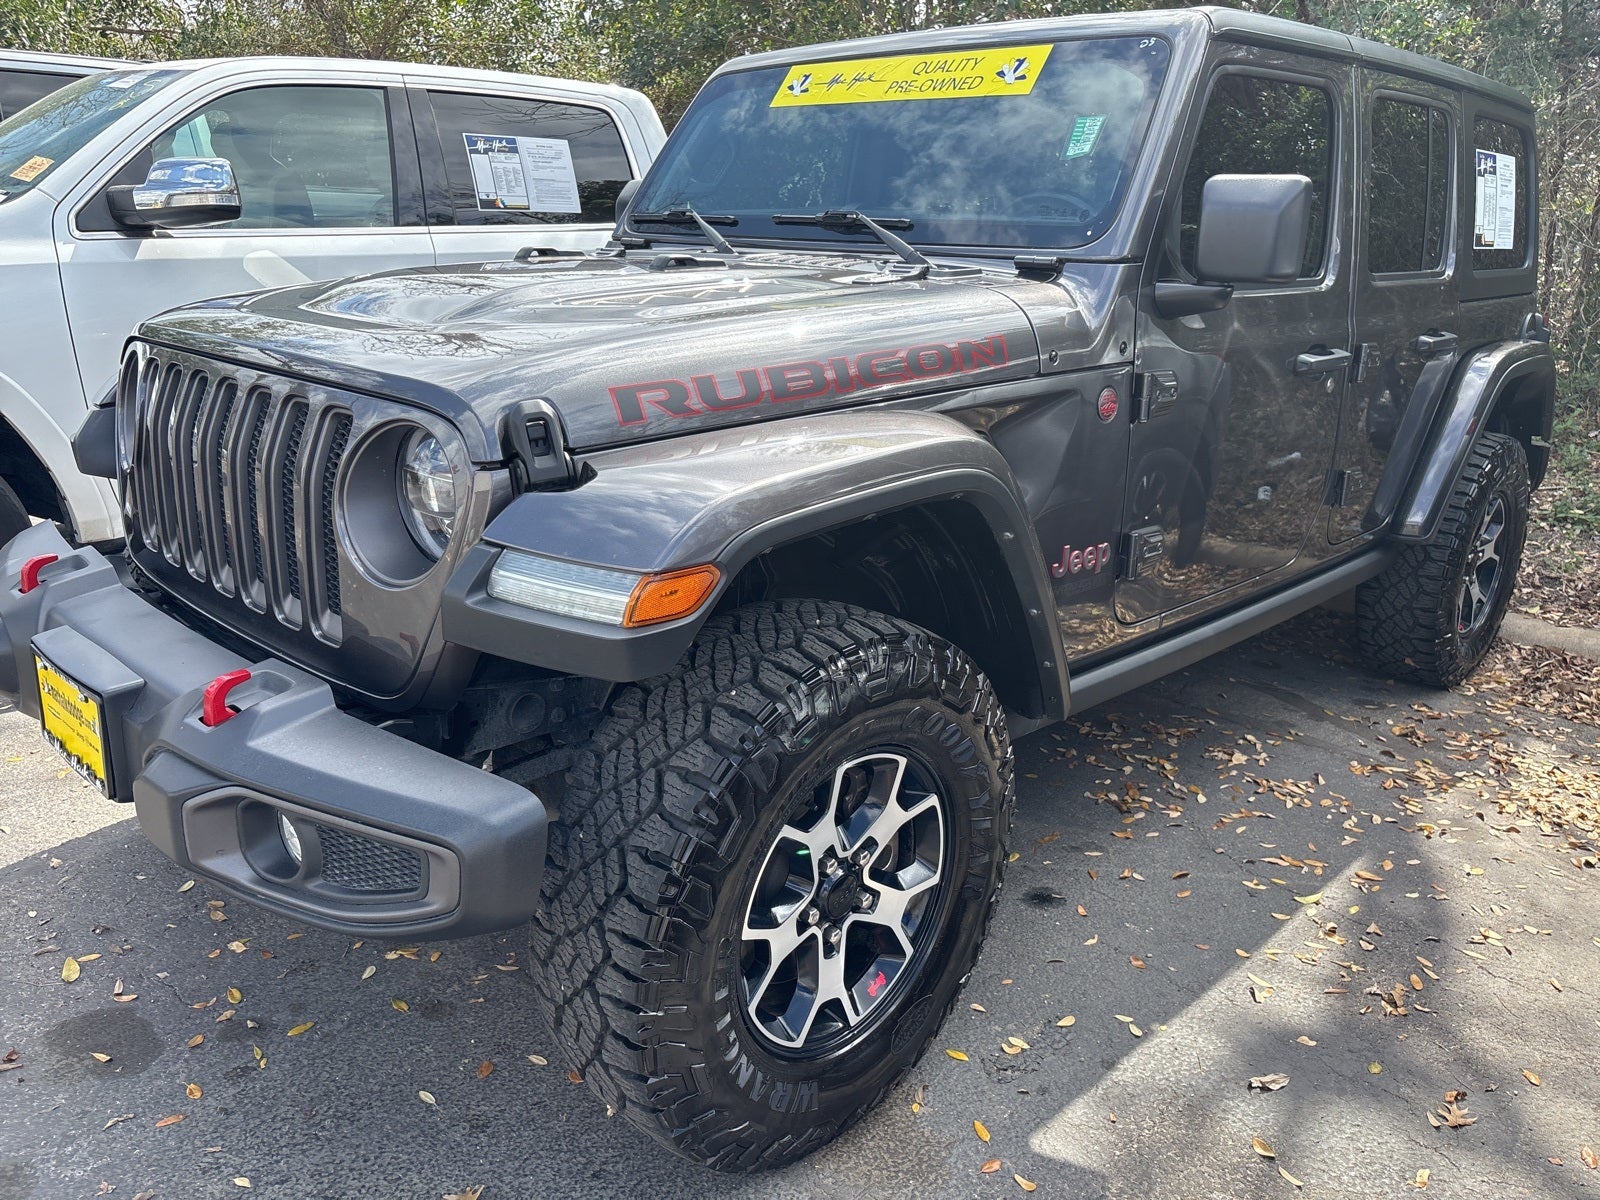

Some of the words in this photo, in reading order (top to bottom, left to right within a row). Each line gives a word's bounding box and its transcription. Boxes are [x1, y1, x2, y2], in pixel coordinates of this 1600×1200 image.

[885, 76, 984, 94] PRE-OWNED
[912, 57, 986, 75] QUALITY
[608, 334, 1009, 427] RUBICON
[1051, 542, 1111, 578] Jeep
[902, 706, 993, 902] GOODYEAR
[714, 937, 818, 1113] WRANGLER
